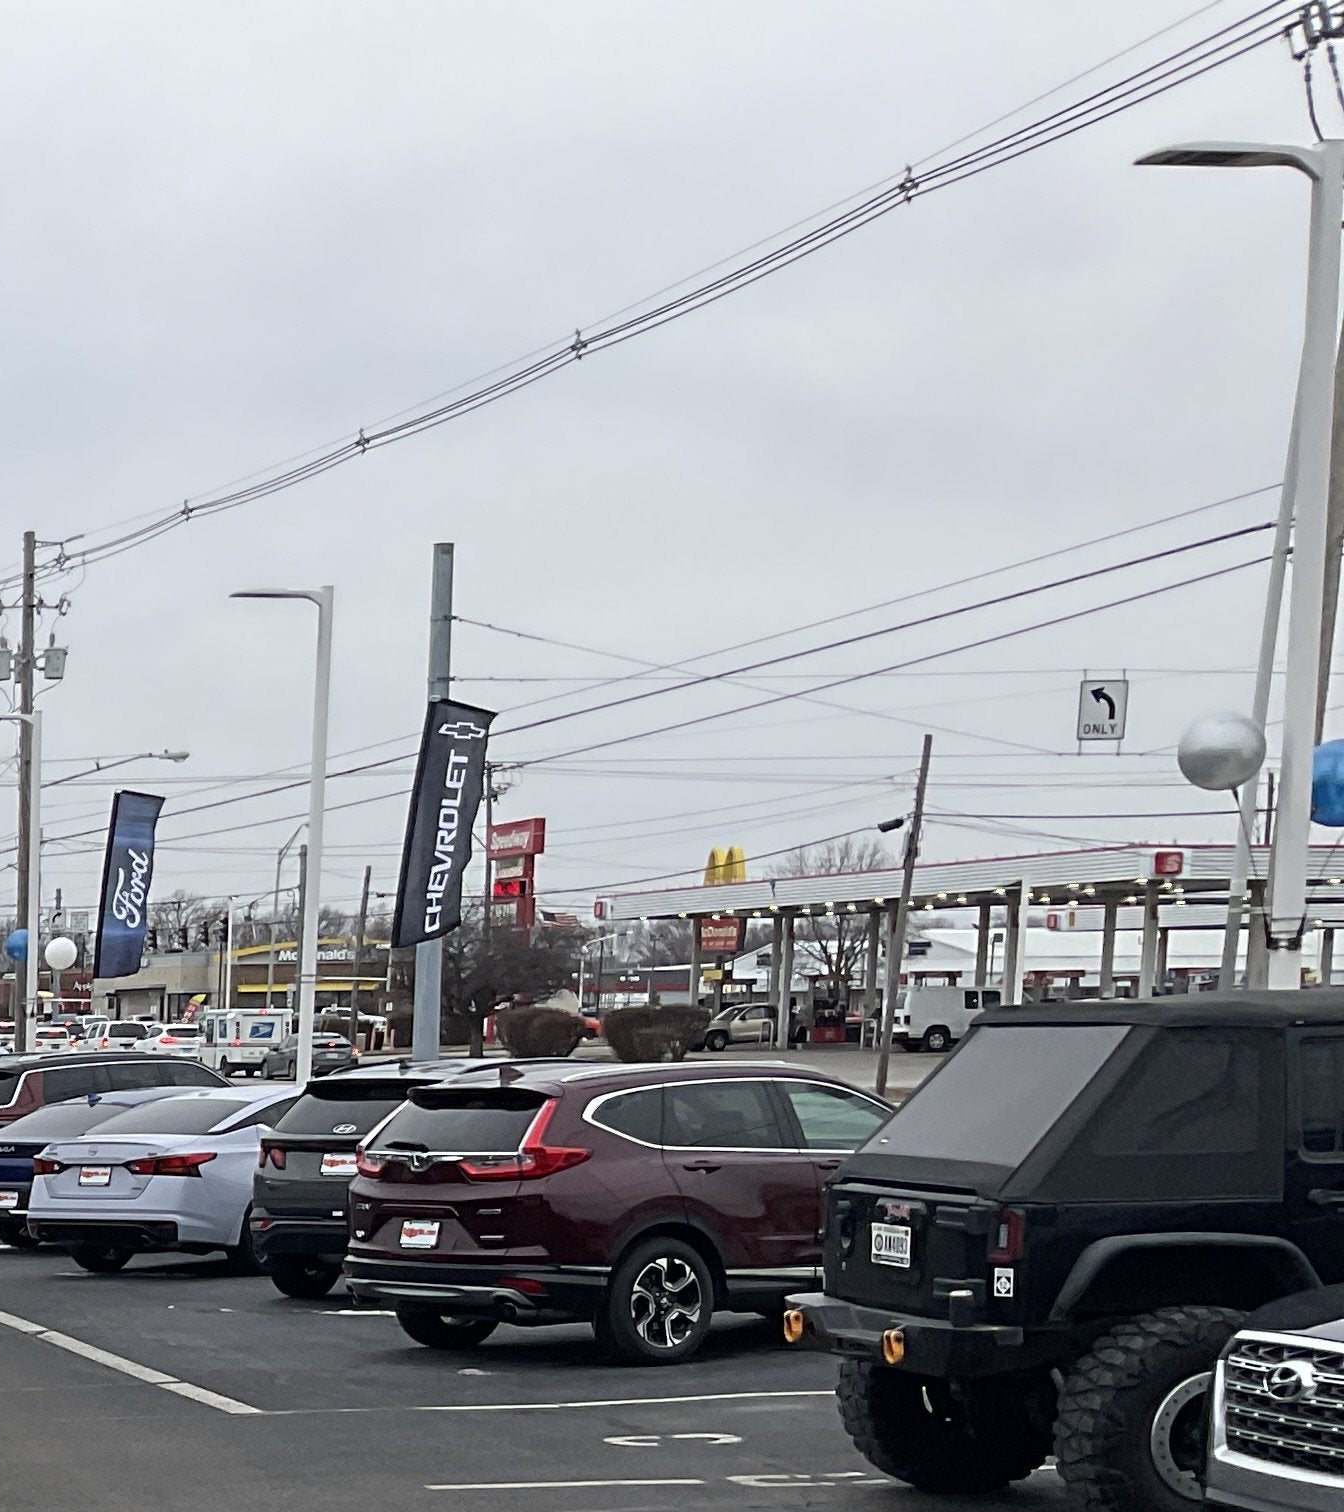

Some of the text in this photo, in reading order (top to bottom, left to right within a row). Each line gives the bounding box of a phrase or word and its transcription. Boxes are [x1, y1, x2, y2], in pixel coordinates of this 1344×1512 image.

[1083, 723, 1118, 735] ONLY
[424, 748, 469, 934] CHEVROLET
[113, 848, 149, 929] Ford
[278, 950, 356, 962] Mcnald's
